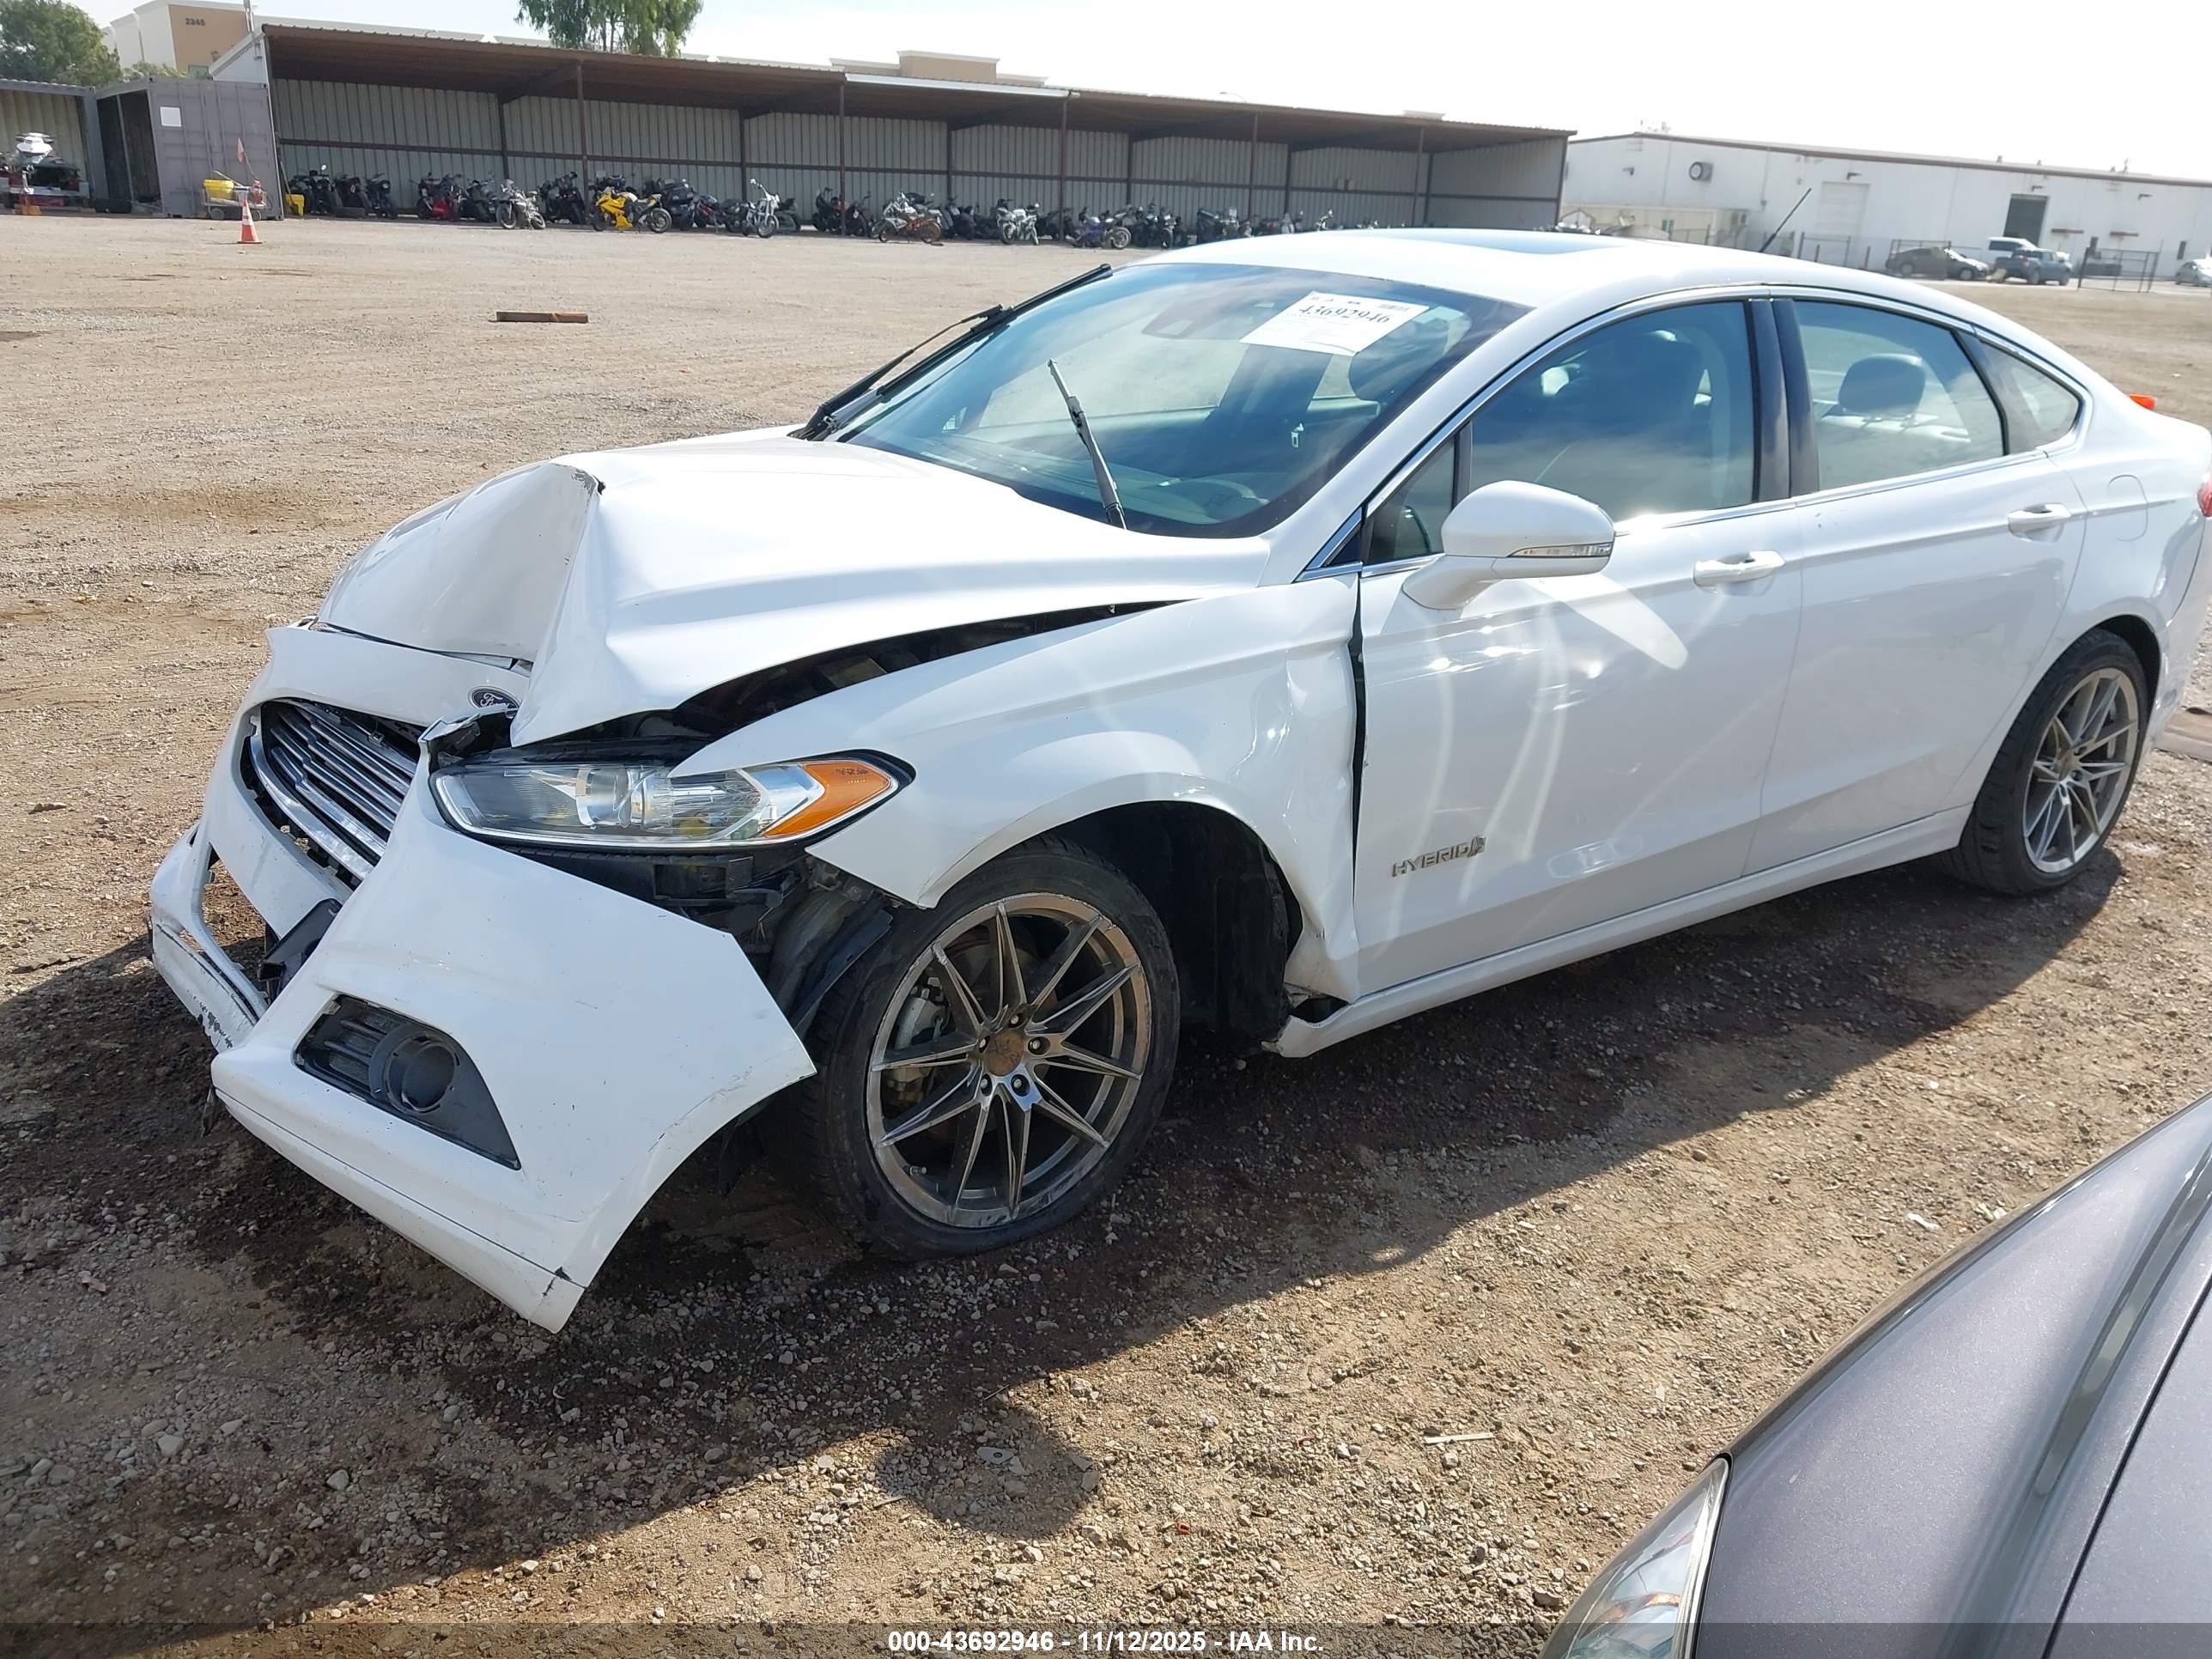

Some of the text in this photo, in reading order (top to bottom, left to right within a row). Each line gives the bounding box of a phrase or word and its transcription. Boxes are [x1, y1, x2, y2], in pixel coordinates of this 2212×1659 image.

[185, 17, 205, 27] 2345
[1298, 305, 1391, 324] 43692946
[1391, 842, 1470, 878] HYBRID
